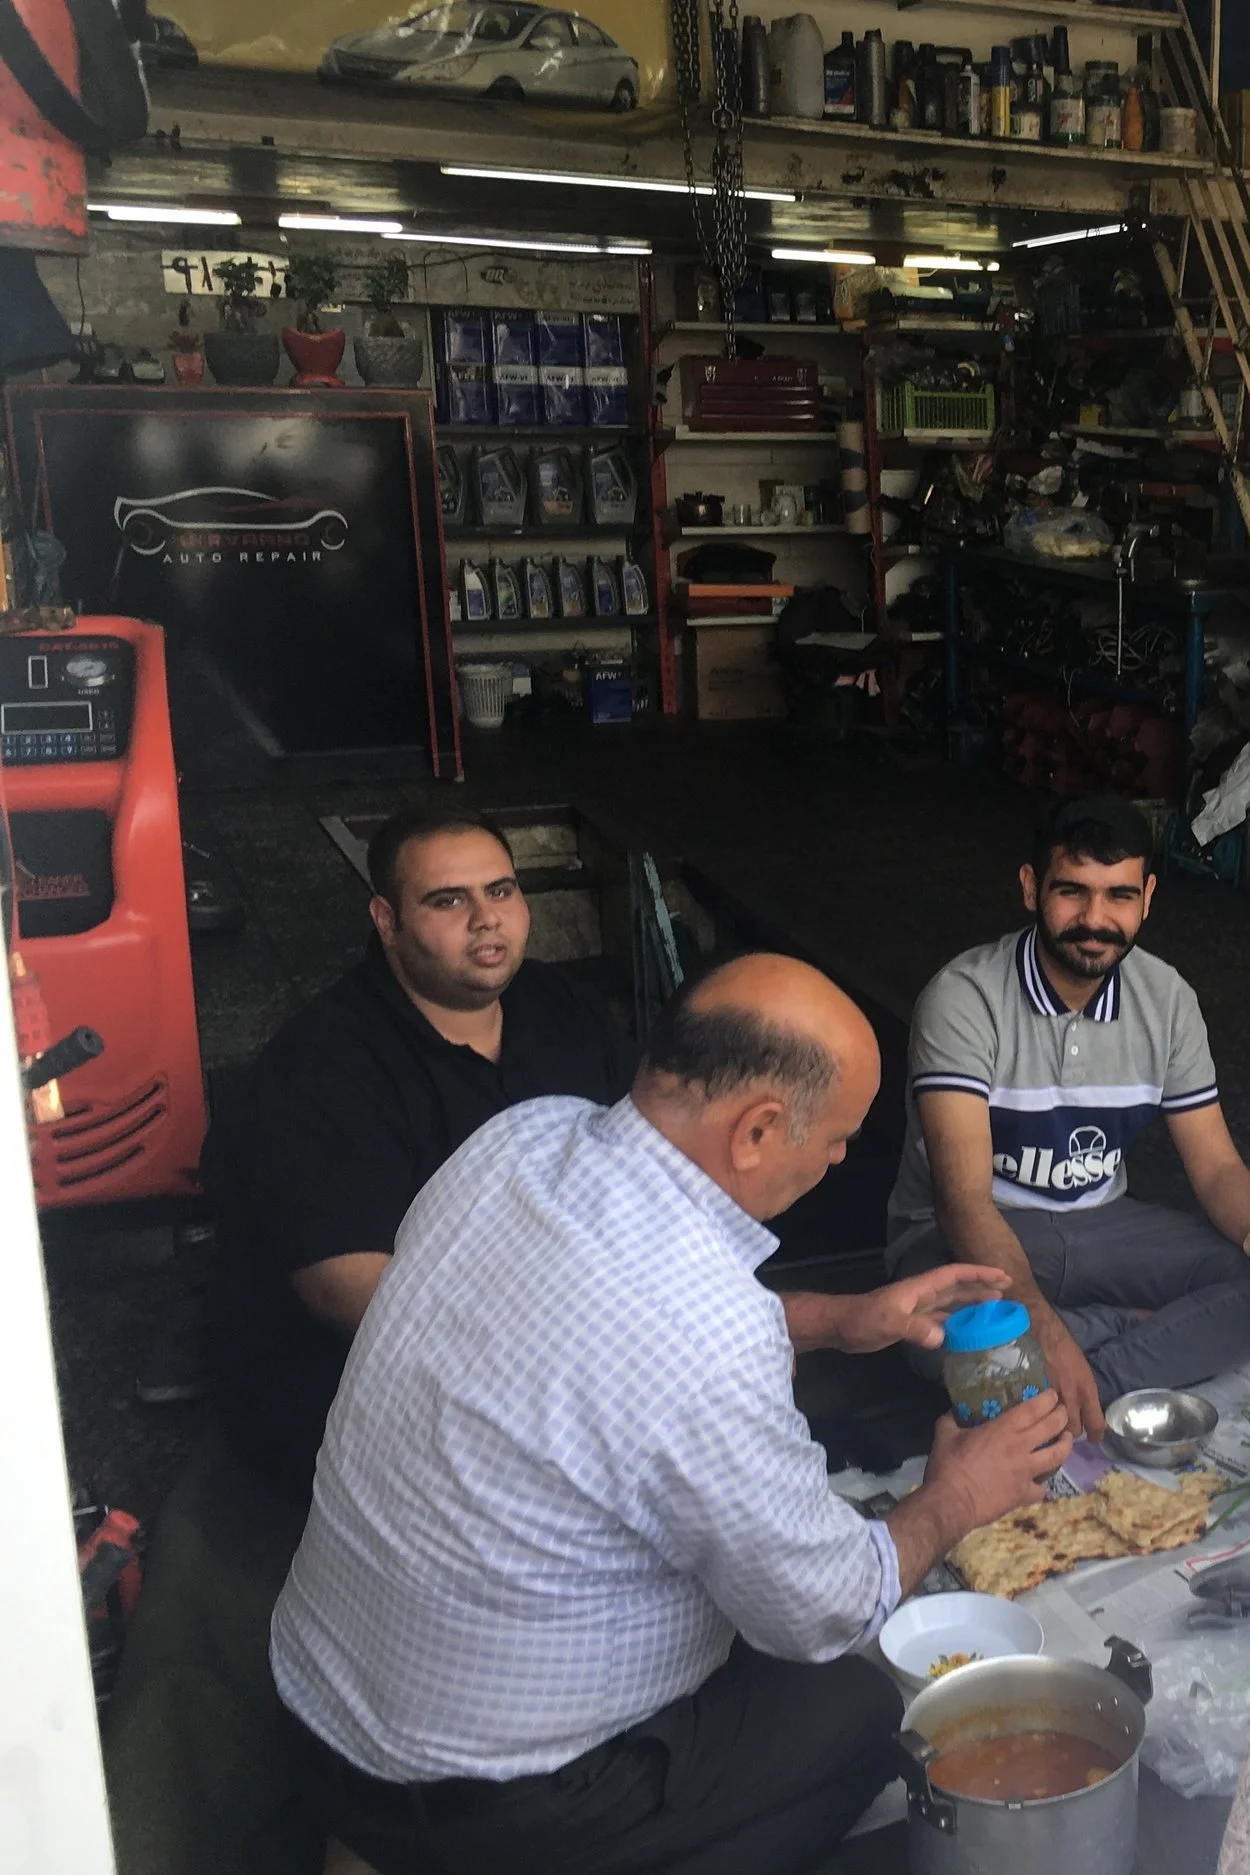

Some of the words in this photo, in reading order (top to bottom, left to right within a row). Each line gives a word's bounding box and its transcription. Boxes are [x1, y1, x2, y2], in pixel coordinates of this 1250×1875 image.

[163, 553, 222, 564] AUTO
[240, 551, 322, 563] REPAIR
[993, 1145, 1122, 1190] ellesse
